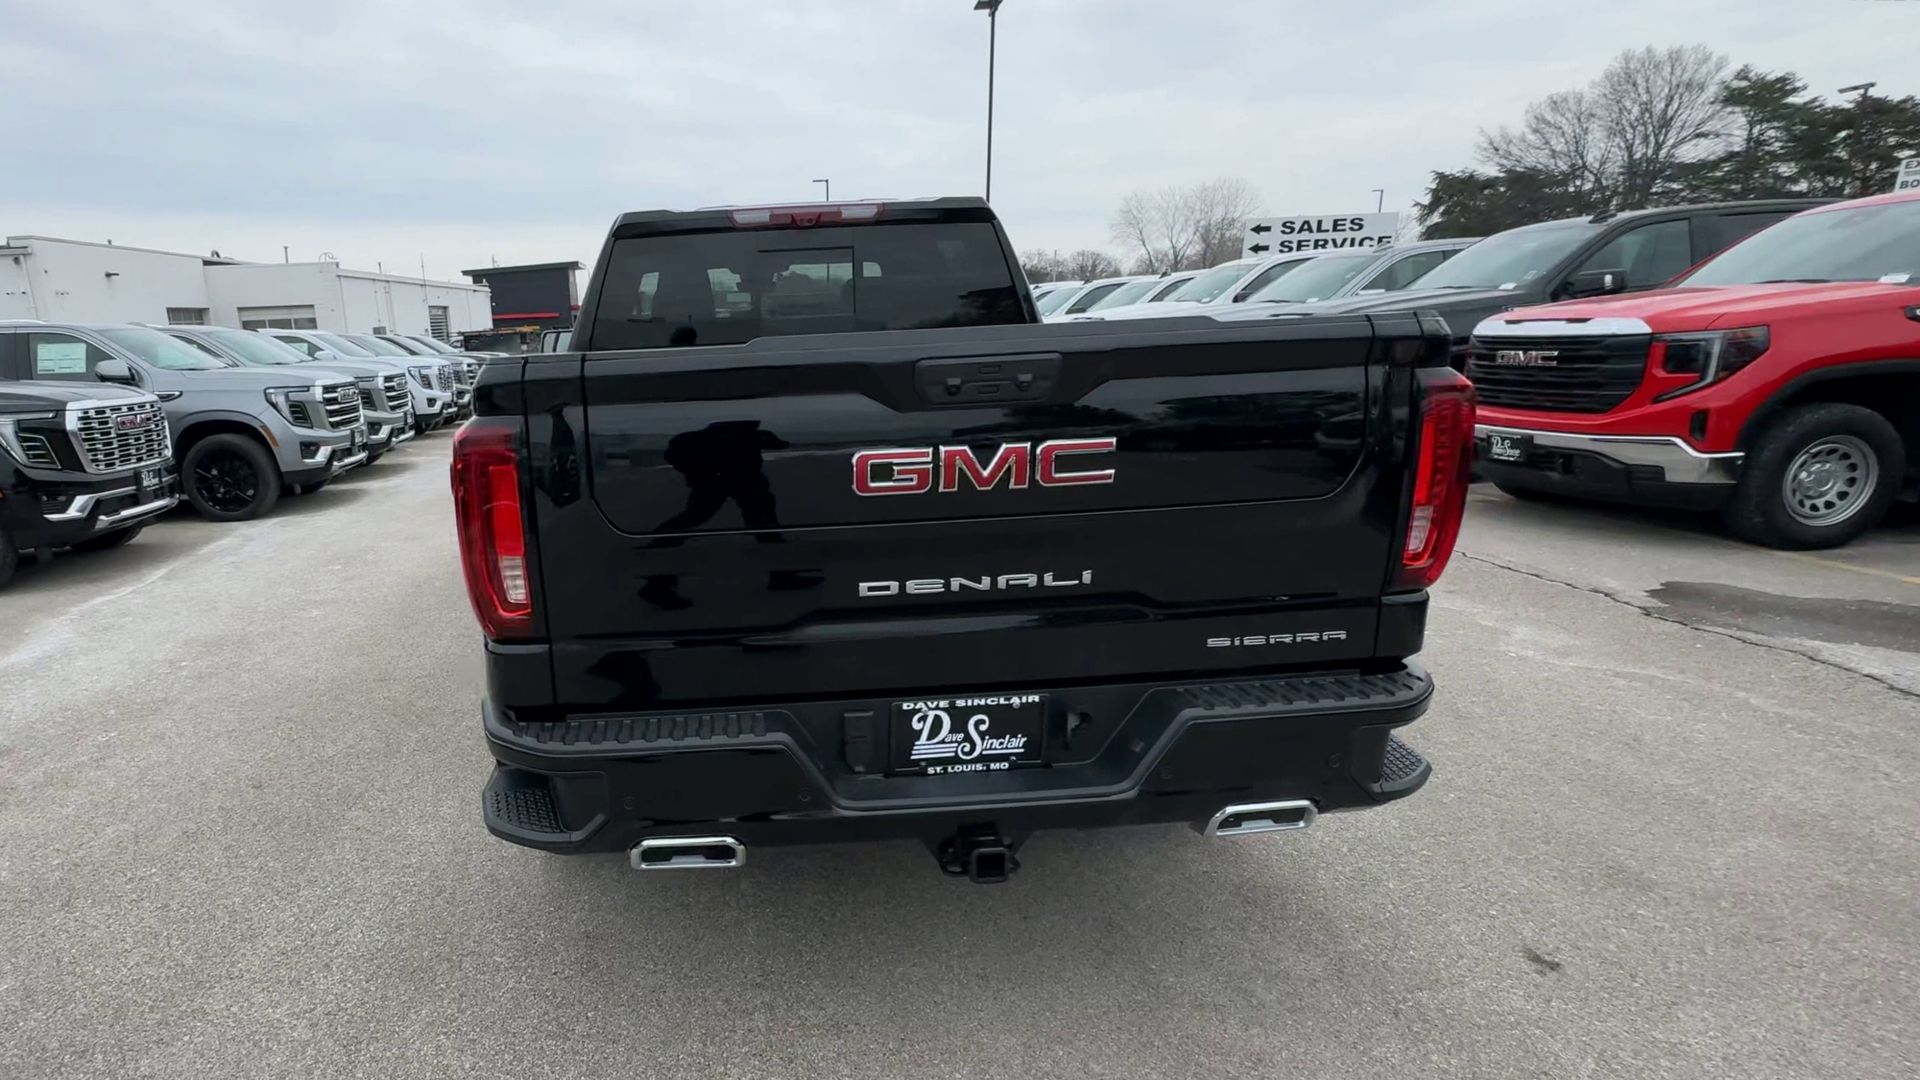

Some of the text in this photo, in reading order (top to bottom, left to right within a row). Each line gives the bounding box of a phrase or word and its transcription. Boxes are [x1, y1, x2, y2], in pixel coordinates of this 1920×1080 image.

[1280, 217, 1365, 235] SALES
[1278, 235, 1393, 254] SERVICE
[1496, 350, 1559, 367] GMC
[852, 437, 1117, 496] GMC
[858, 570, 1093, 597] DENALI
[1206, 630, 1347, 647] SIERRA
[902, 695, 1040, 710] DAVE SINCLAIR
[911, 709, 1028, 760] Dave Sinclair
[927, 766, 945, 774] ST.
[990, 762, 1010, 770] MO
